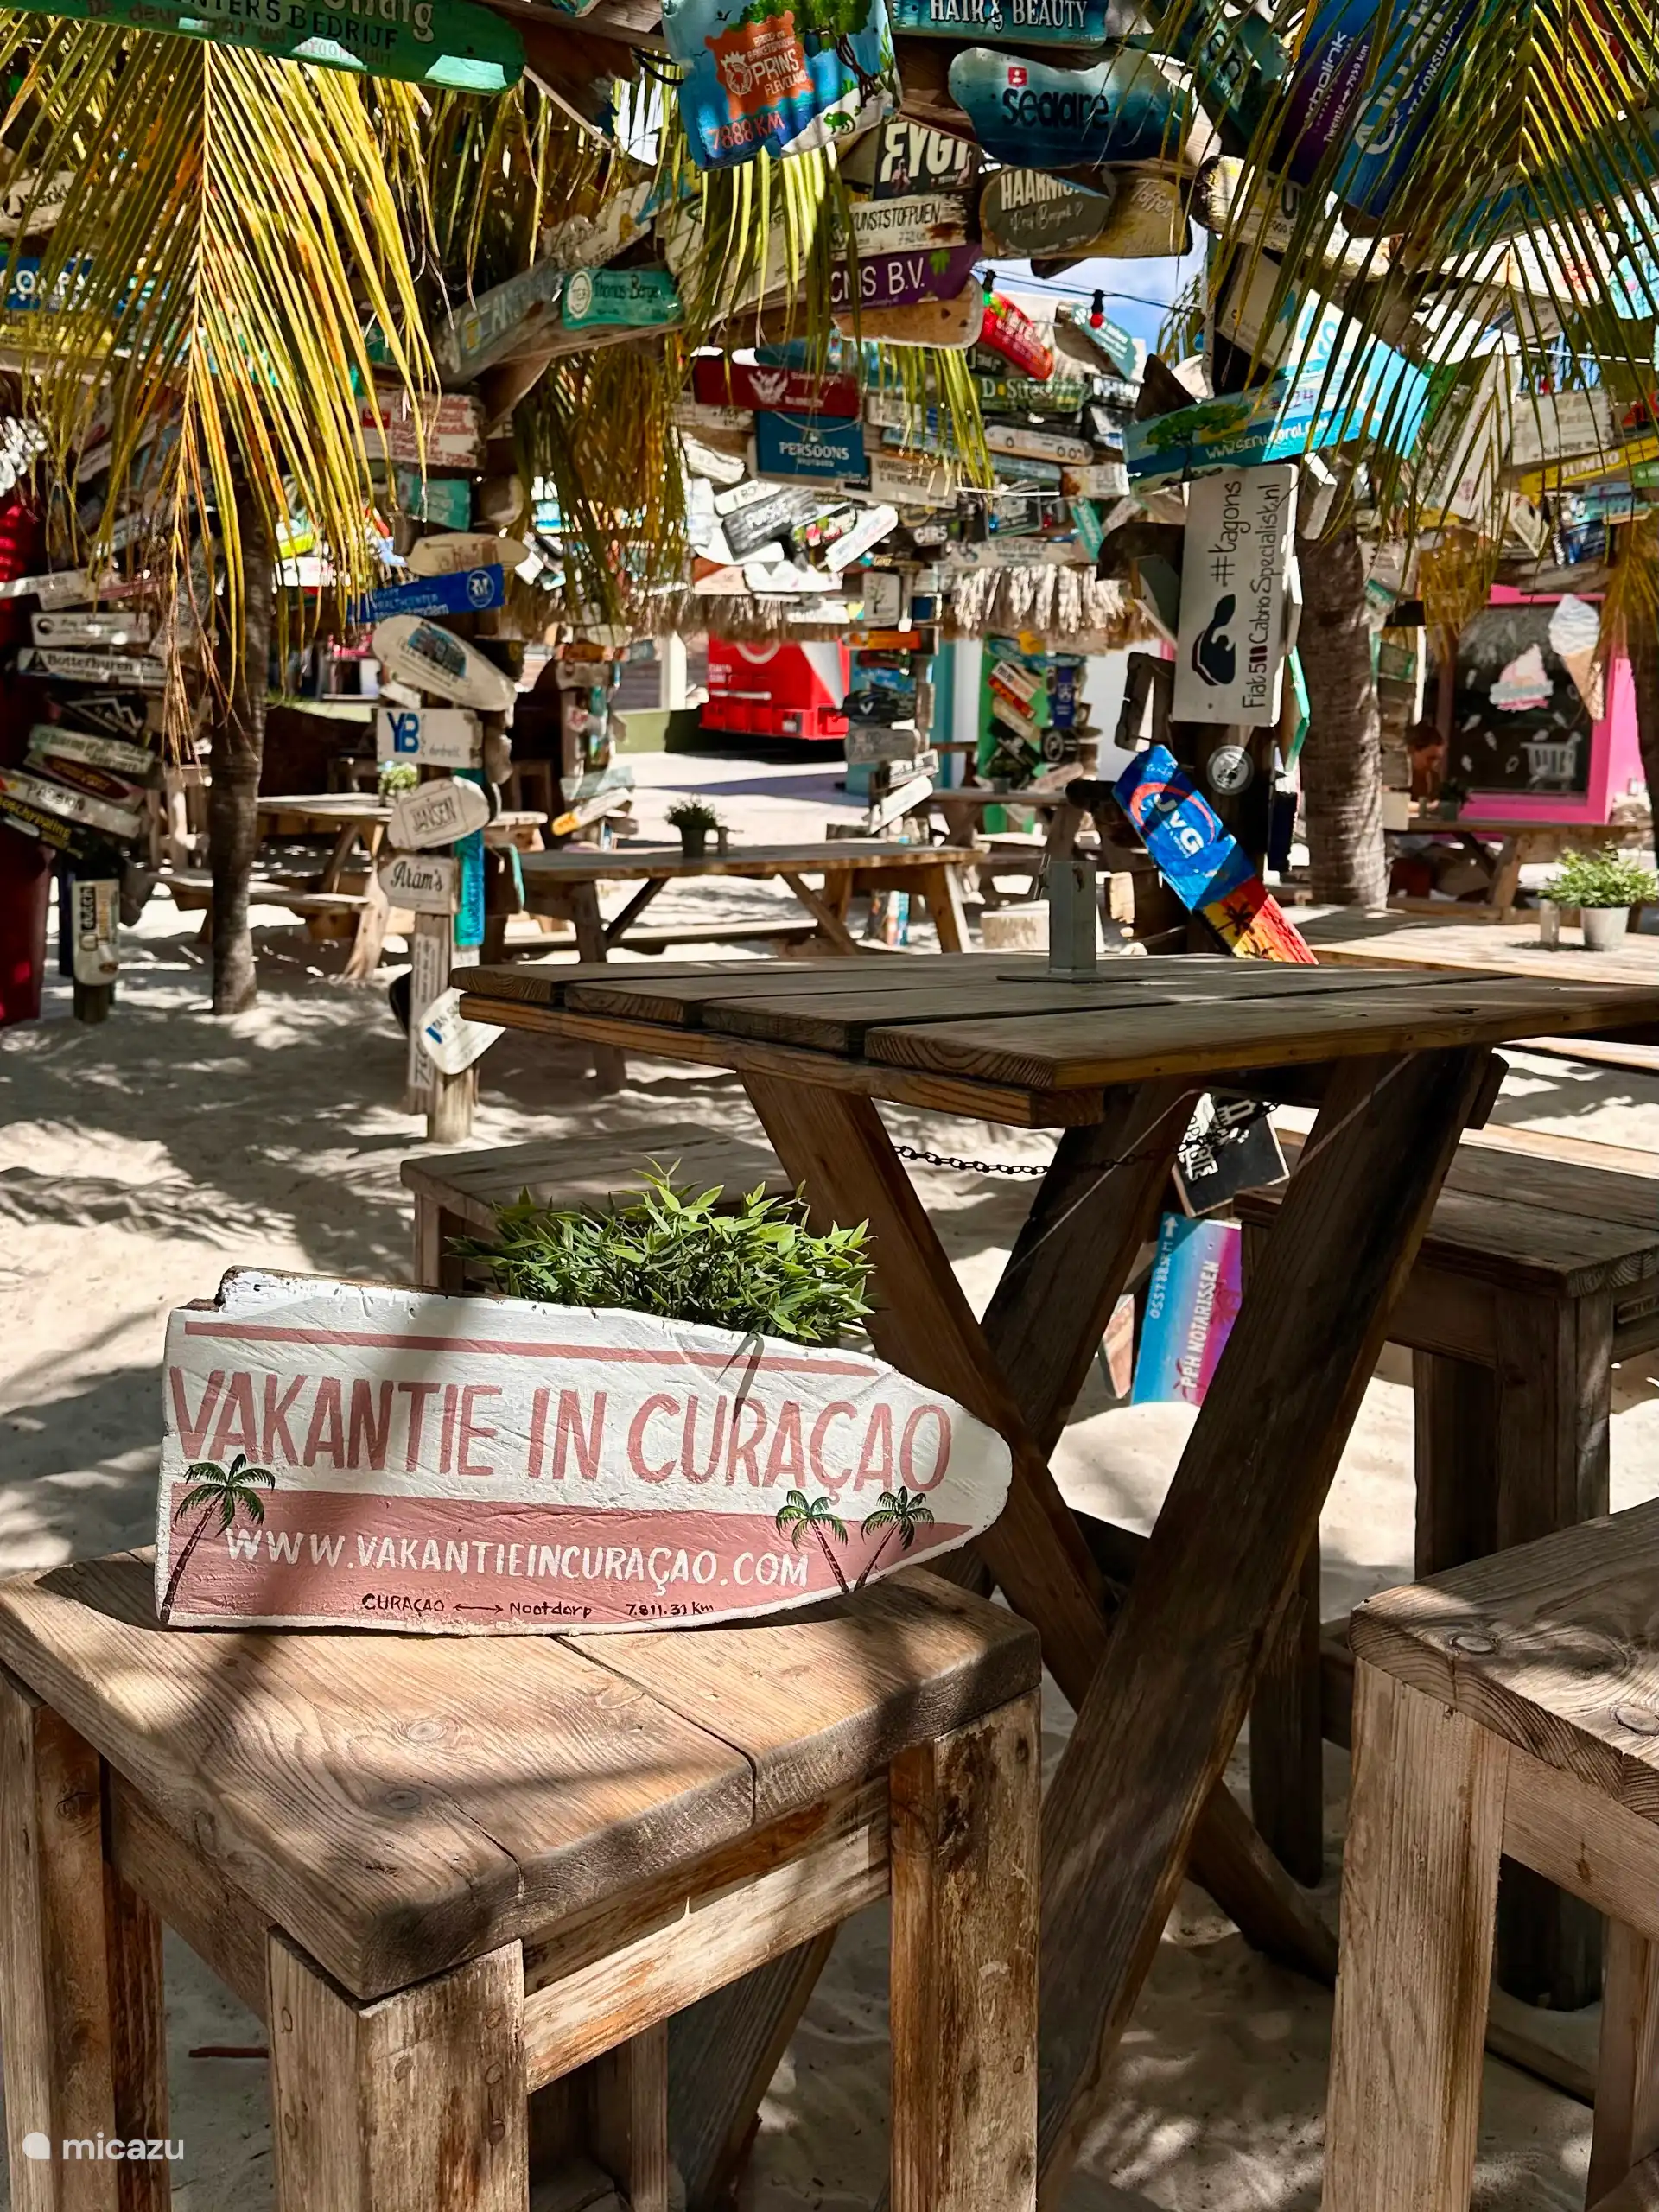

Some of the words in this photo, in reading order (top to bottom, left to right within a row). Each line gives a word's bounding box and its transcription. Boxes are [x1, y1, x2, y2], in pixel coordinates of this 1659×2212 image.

[930, 0, 985, 22] HAIR
[1013, 0, 1086, 28] BEAUTY
[750, 48, 801, 86] PRINS
[707, 116, 753, 152] 7888
[753, 111, 786, 140] KM
[888, 257, 925, 296] B.V.
[779, 440, 851, 461] PERSOONS
[386, 711, 420, 753] YB
[1185, 1261, 1221, 1356] NOTARISSEN
[1180, 1355, 1200, 1389] PPH
[169, 1366, 503, 1477] VAKANTIE
[528, 1386, 607, 1480] IN
[626, 1392, 952, 1506] CURAÇAO
[225, 1526, 810, 1597] WWW.VAKANTIEINCURAÇAO.COM
[361, 1592, 446, 1616] CURAÇAO
[510, 1600, 593, 1620] Nootdorp
[690, 1600, 715, 1615] Km
